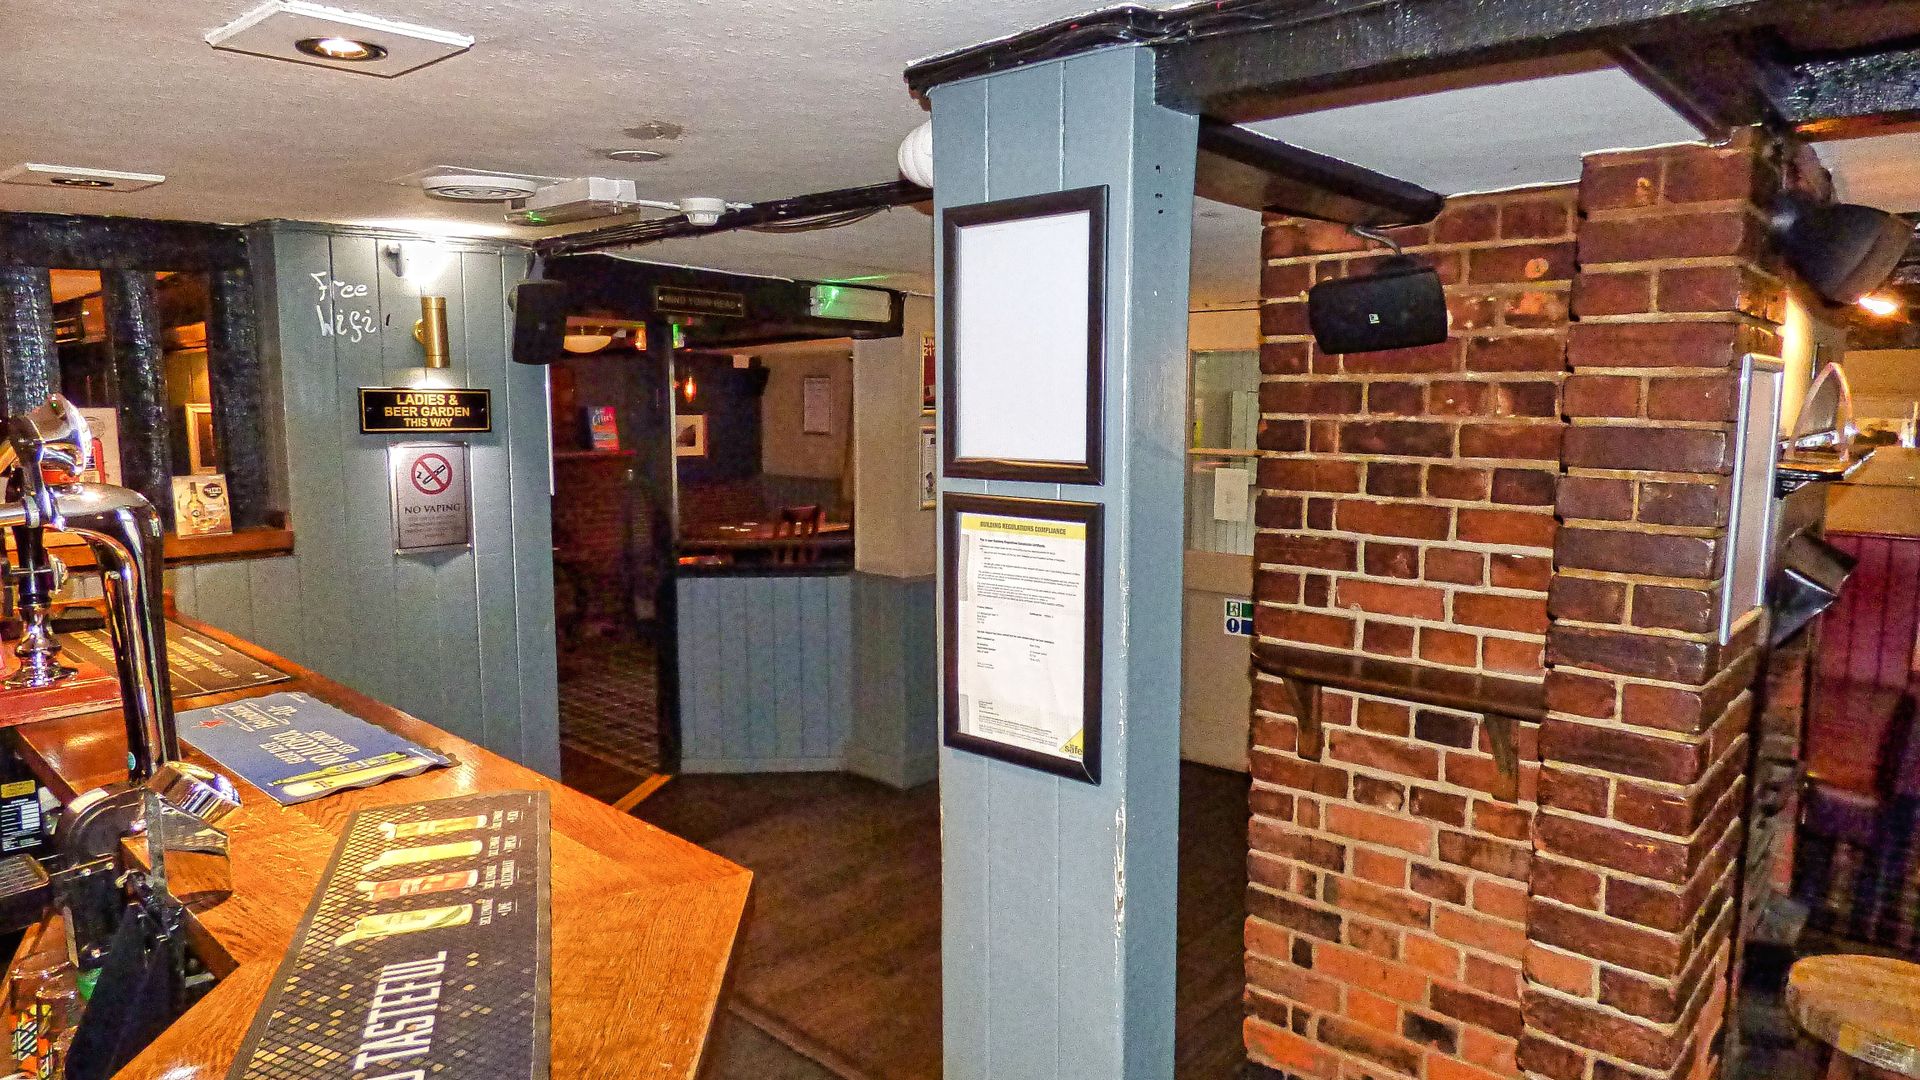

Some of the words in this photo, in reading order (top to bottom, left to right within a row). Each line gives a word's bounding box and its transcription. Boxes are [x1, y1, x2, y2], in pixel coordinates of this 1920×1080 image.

[310, 271, 368, 302] Free
[396, 394, 446, 406] LADIES
[448, 394, 459, 406] &
[384, 406, 418, 417] BEER
[420, 406, 470, 417] GARDEN
[403, 418, 428, 427] THIS
[430, 418, 453, 427] WAY
[404, 505, 421, 514] NO
[424, 503, 461, 513] VAPING
[980, 521, 1002, 529] BUILDING
[1002, 523, 1034, 532] REGULATIONS
[1035, 526, 1067, 535] COMPLIANCE
[269, 730, 333, 756] ALCOHOL
[309, 752, 350, 766] NO
[353, 950, 448, 1070] TASTEFUL
